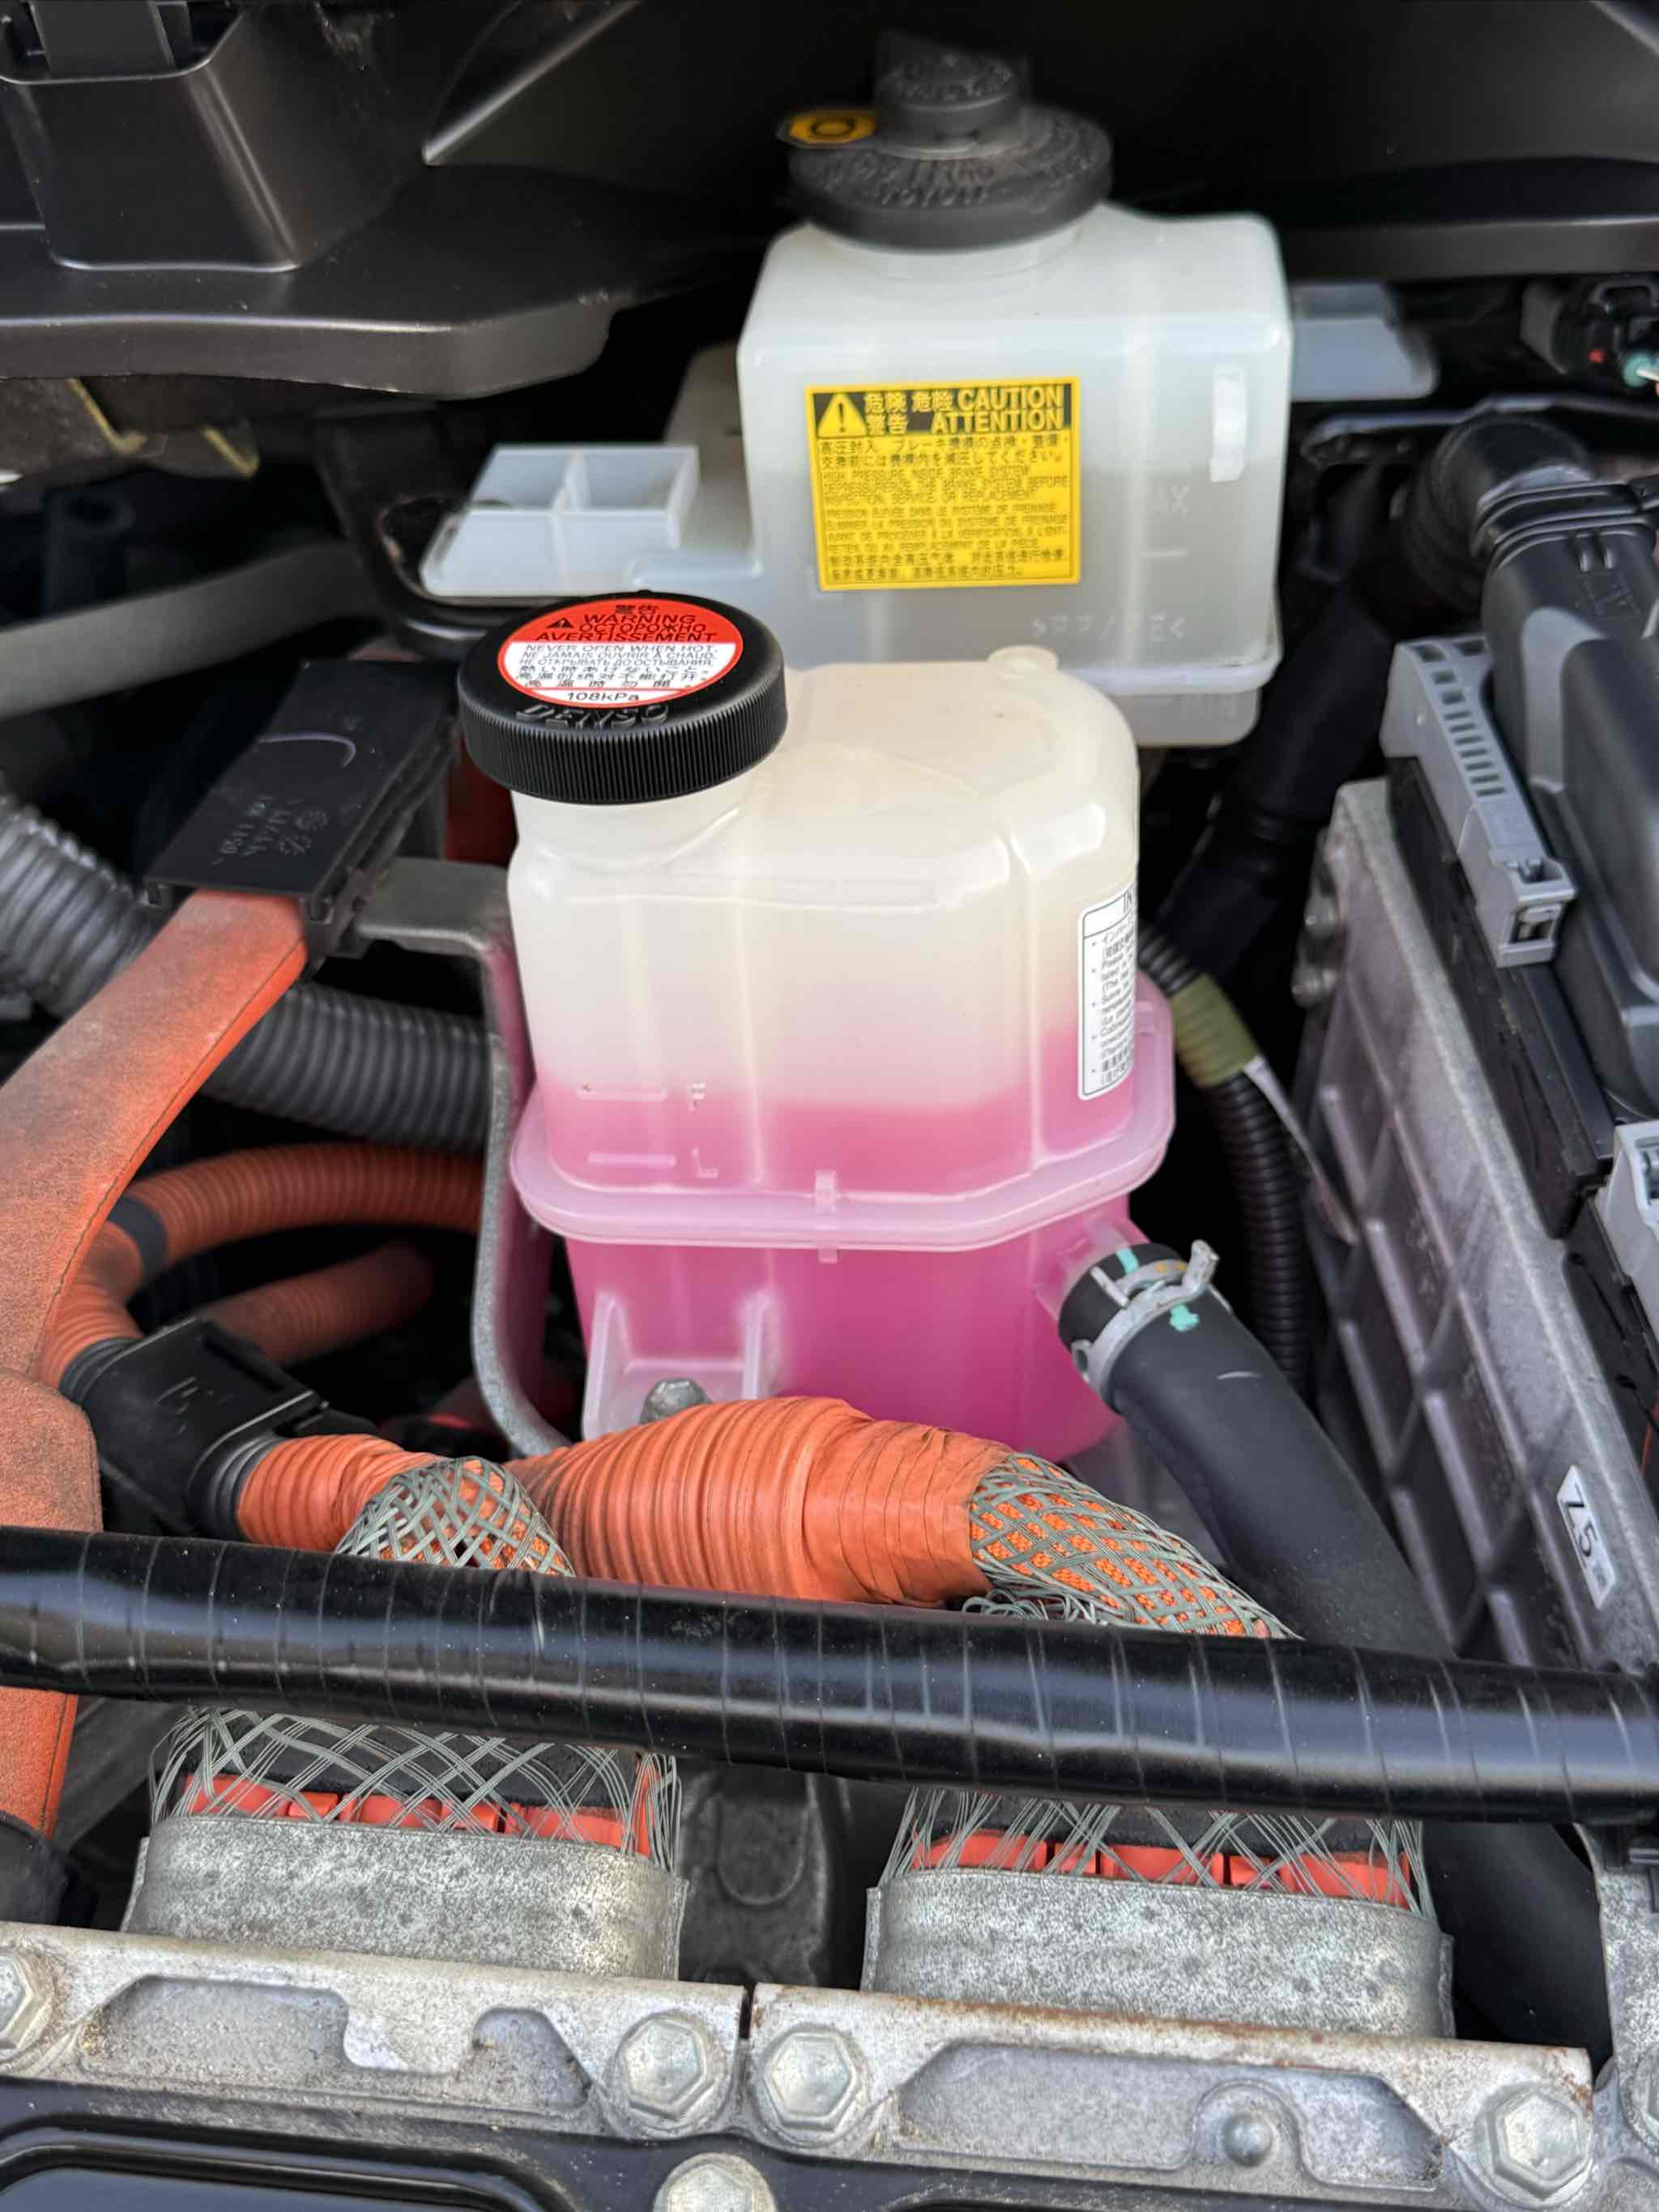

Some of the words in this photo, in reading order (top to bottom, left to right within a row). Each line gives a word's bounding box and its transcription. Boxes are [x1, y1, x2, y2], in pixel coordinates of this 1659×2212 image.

[958, 386, 1063, 411] CAUTION
[932, 411, 1063, 436] ATTENTION
[582, 613, 697, 624] WARNING
[535, 632, 718, 641] AVERTISSEMENT
[582, 644, 625, 653] OPEN
[630, 644, 676, 653] WHEN
[567, 692, 640, 701] 108kPa
[692, 1147, 718, 1178] L
